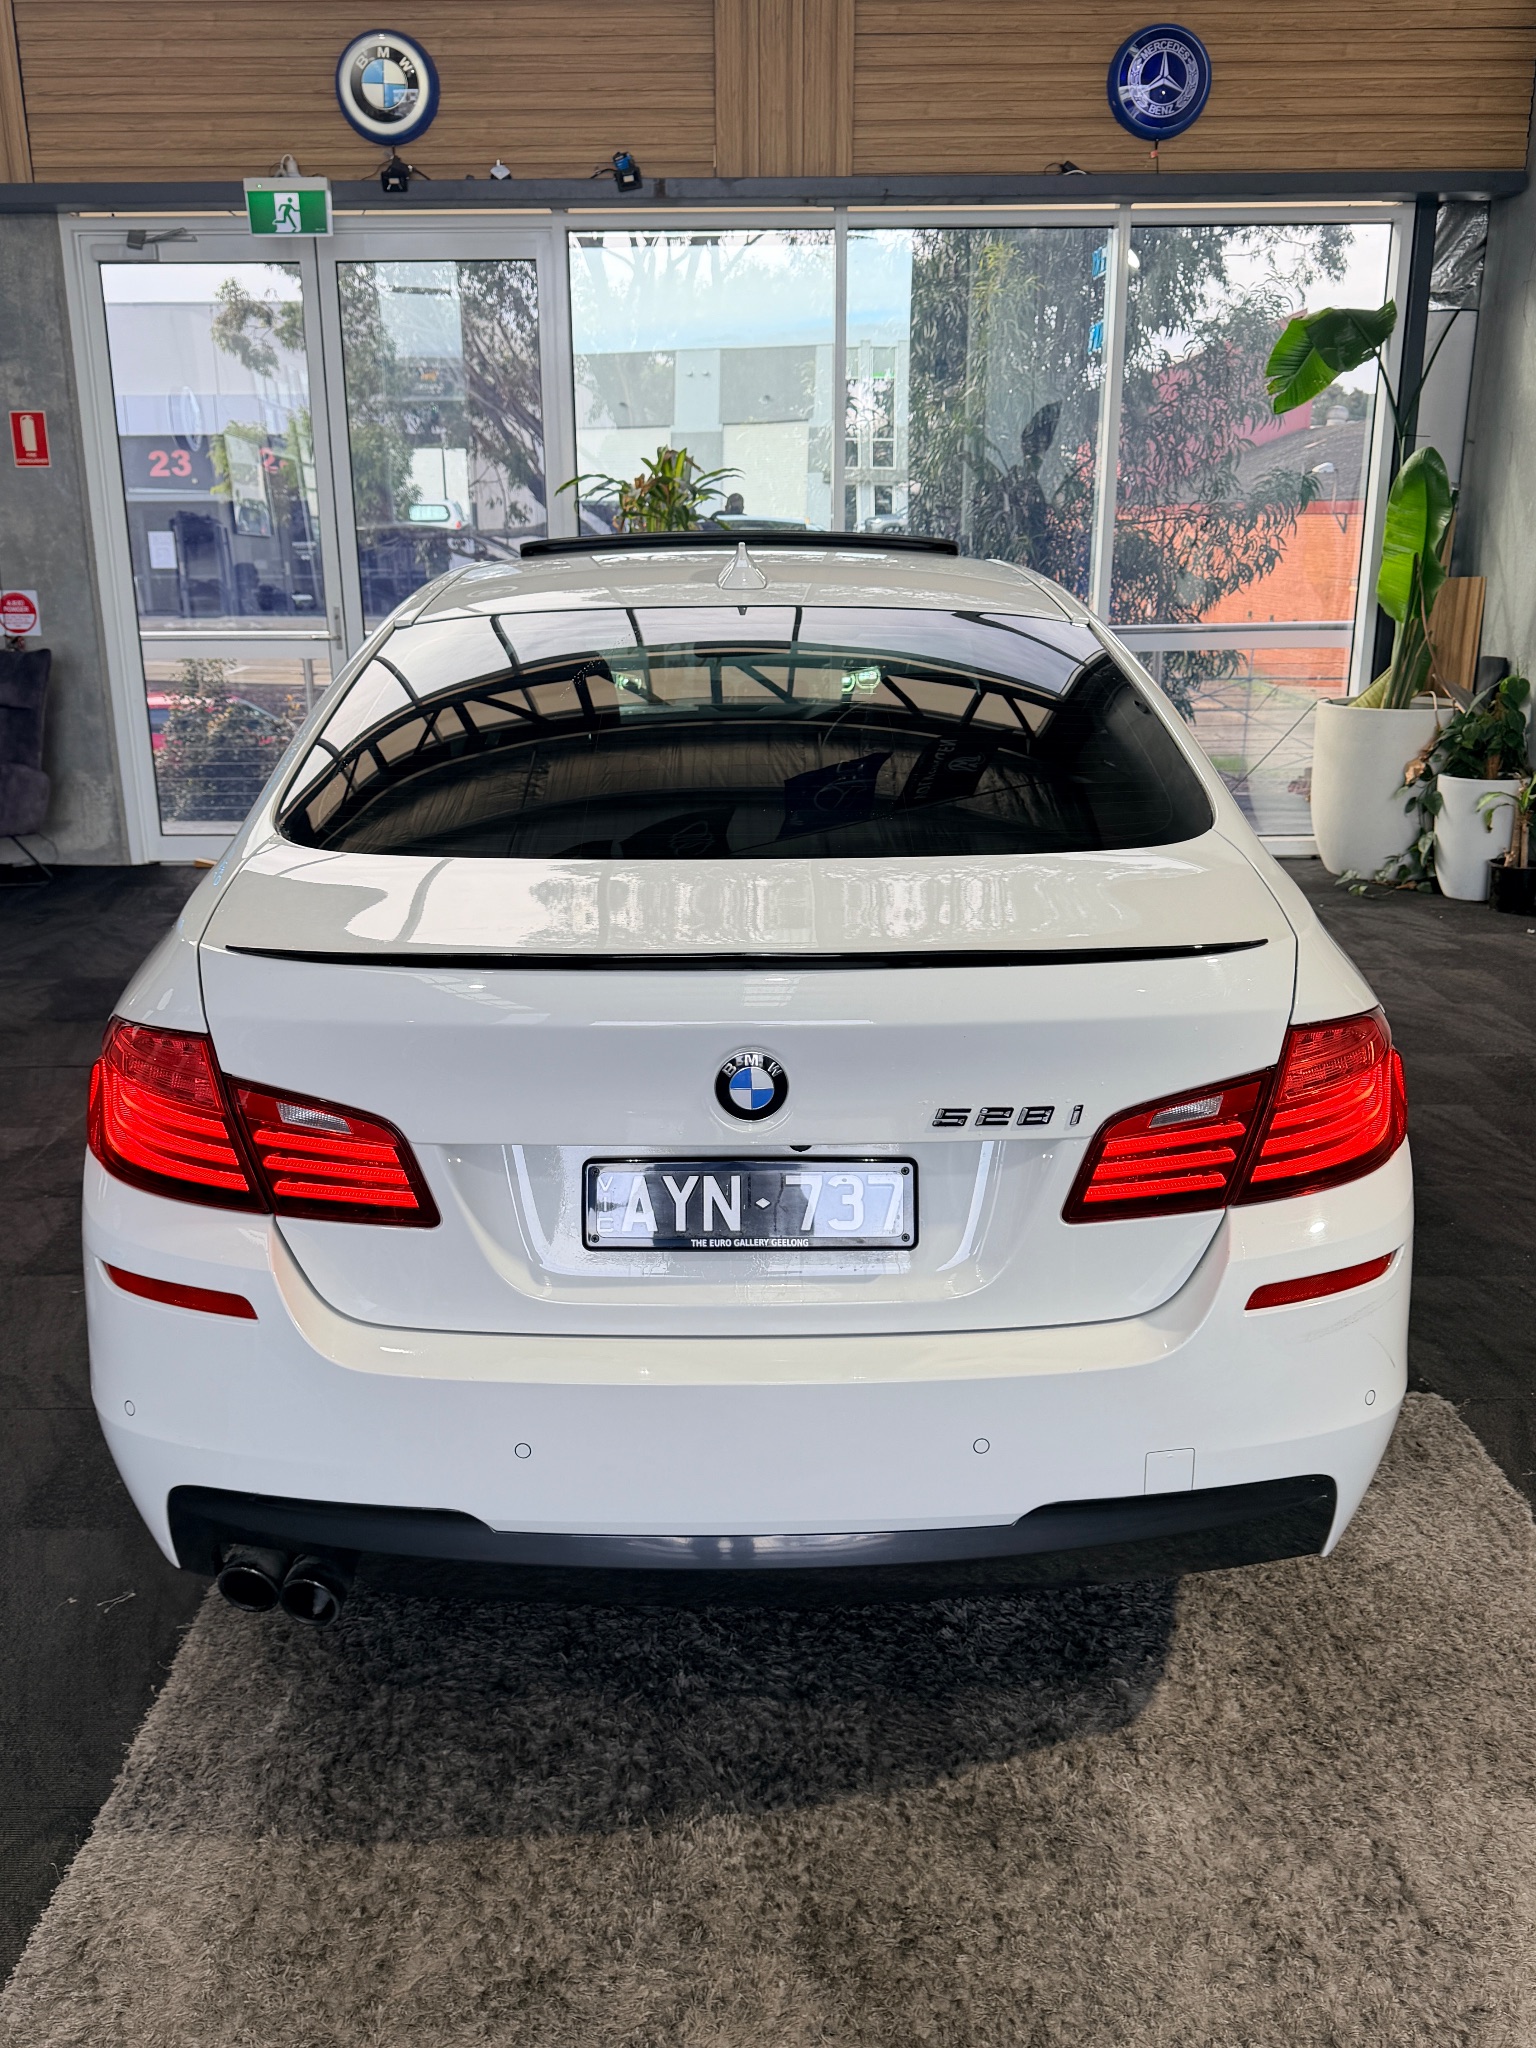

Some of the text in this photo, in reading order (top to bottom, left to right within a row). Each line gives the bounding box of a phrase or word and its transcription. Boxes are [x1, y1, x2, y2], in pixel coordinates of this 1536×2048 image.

[356, 46, 412, 71] BMW
[1140, 41, 1190, 60] MERCEDES
[1148, 104, 1175, 115] BENZ
[148, 450, 192, 477] 23
[722, 1054, 783, 1078] BMW
[597, 1176, 614, 1232] VIC
[691, 1239, 809, 1247] THE EURO GALLERY GEELONG
